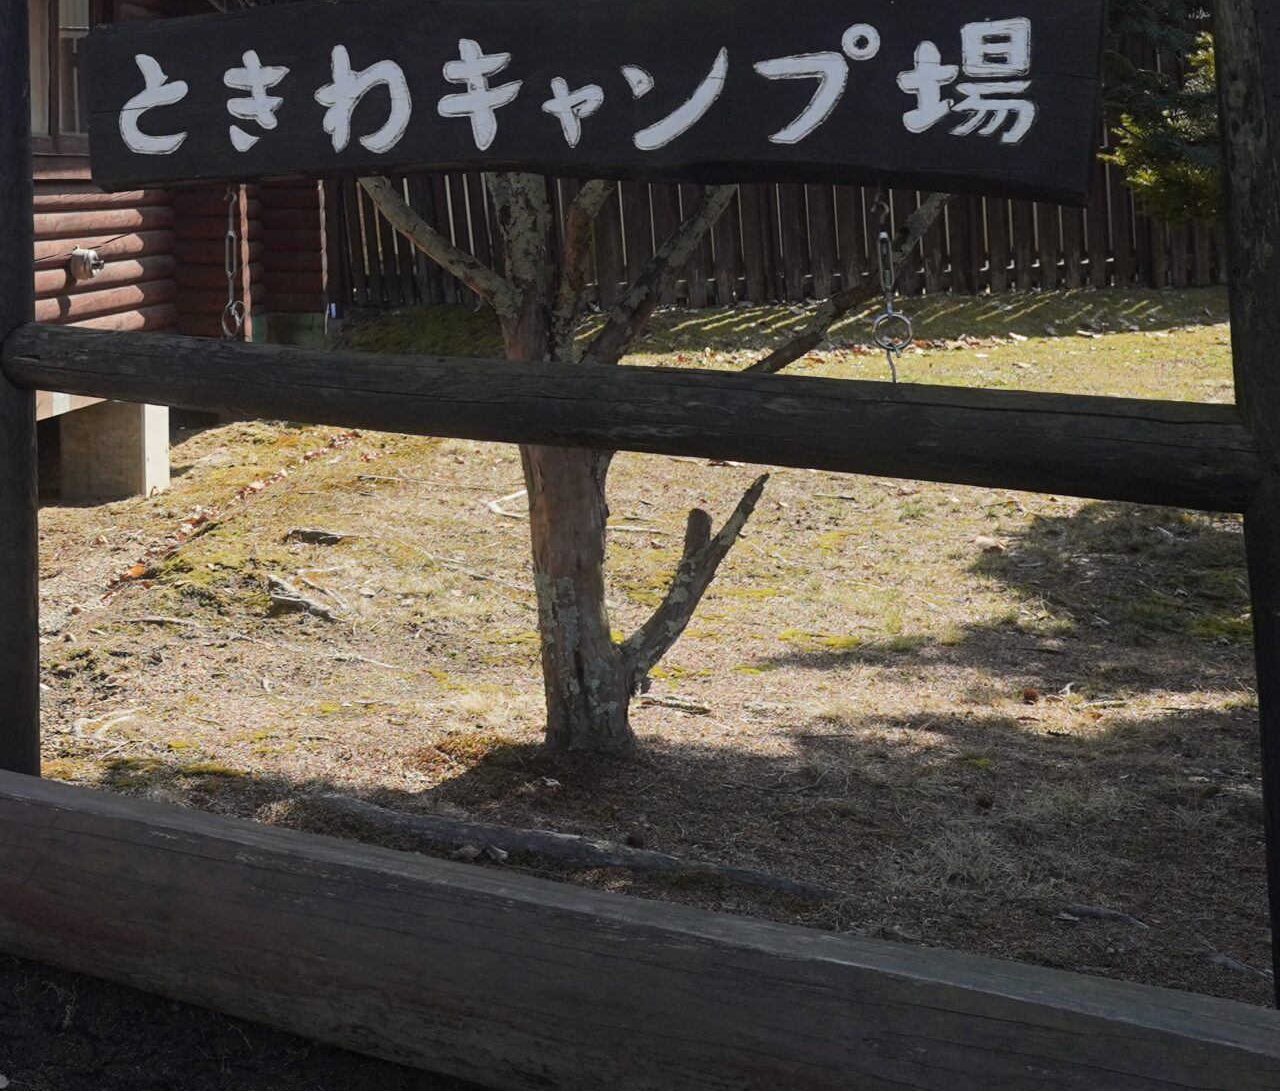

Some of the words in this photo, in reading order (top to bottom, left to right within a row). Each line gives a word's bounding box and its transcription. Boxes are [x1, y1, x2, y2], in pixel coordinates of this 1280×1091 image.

[120, 16, 1038, 156] ときわキャンプ場
